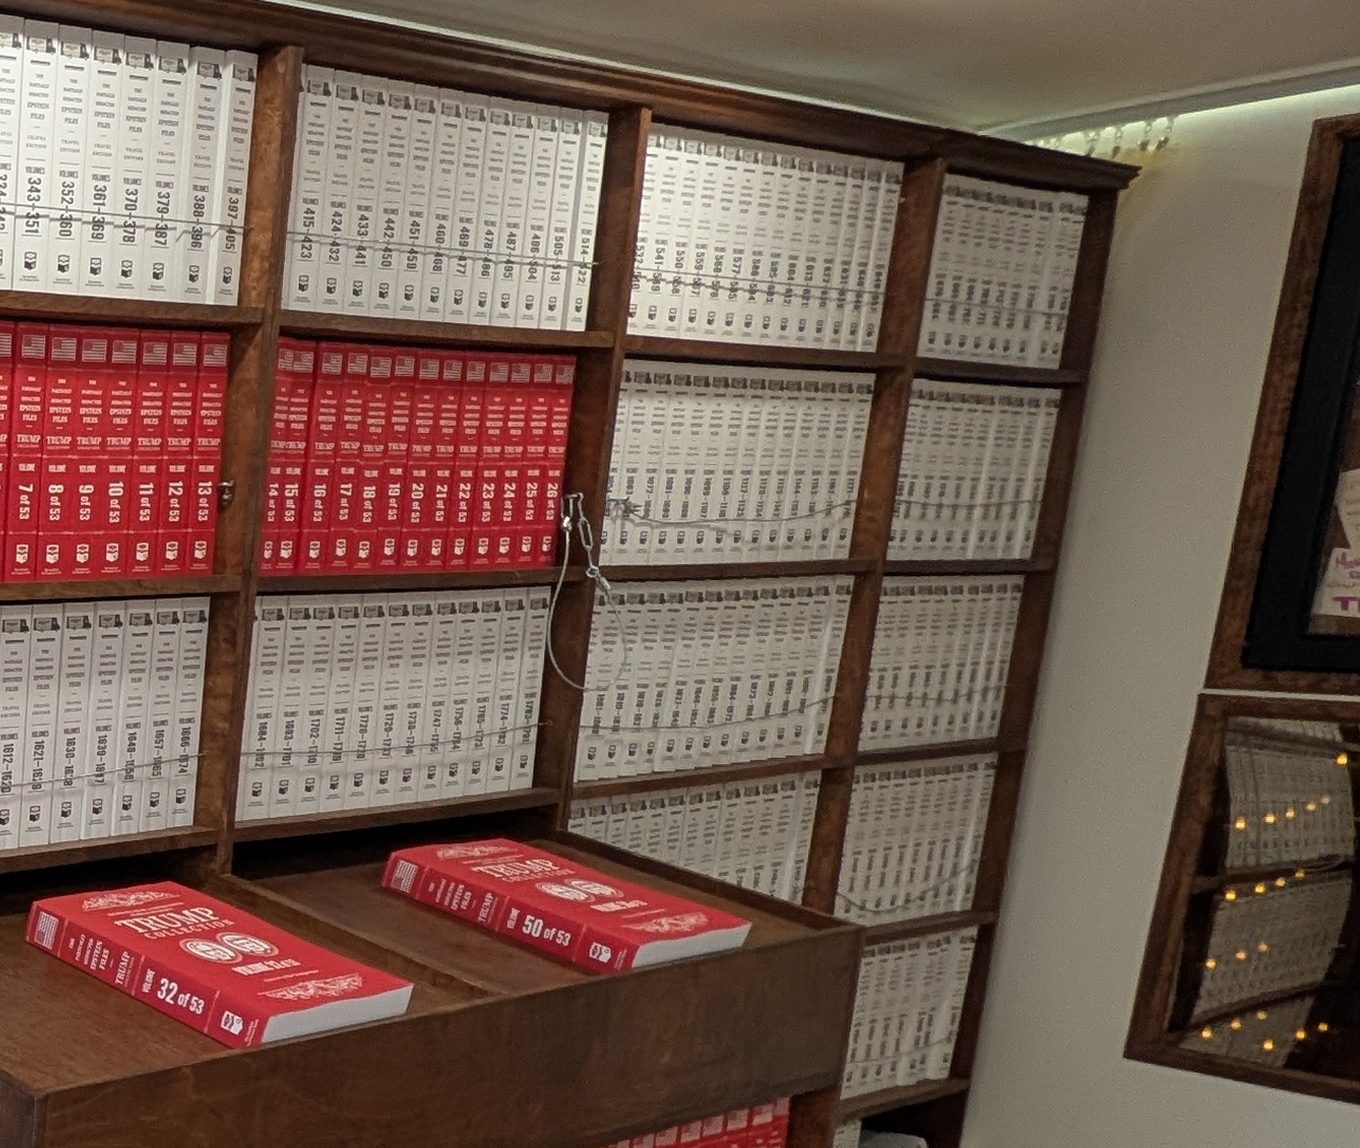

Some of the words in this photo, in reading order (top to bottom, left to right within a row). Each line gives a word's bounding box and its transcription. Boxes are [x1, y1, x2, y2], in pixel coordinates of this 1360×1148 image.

[114, 906, 220, 933] TRUMP
[142, 919, 235, 939] COLLECTION
[115, 951, 130, 985] TRUMP
[157, 977, 178, 1003] 32
[177, 991, 189, 1007] of
[189, 996, 205, 1015] 53
